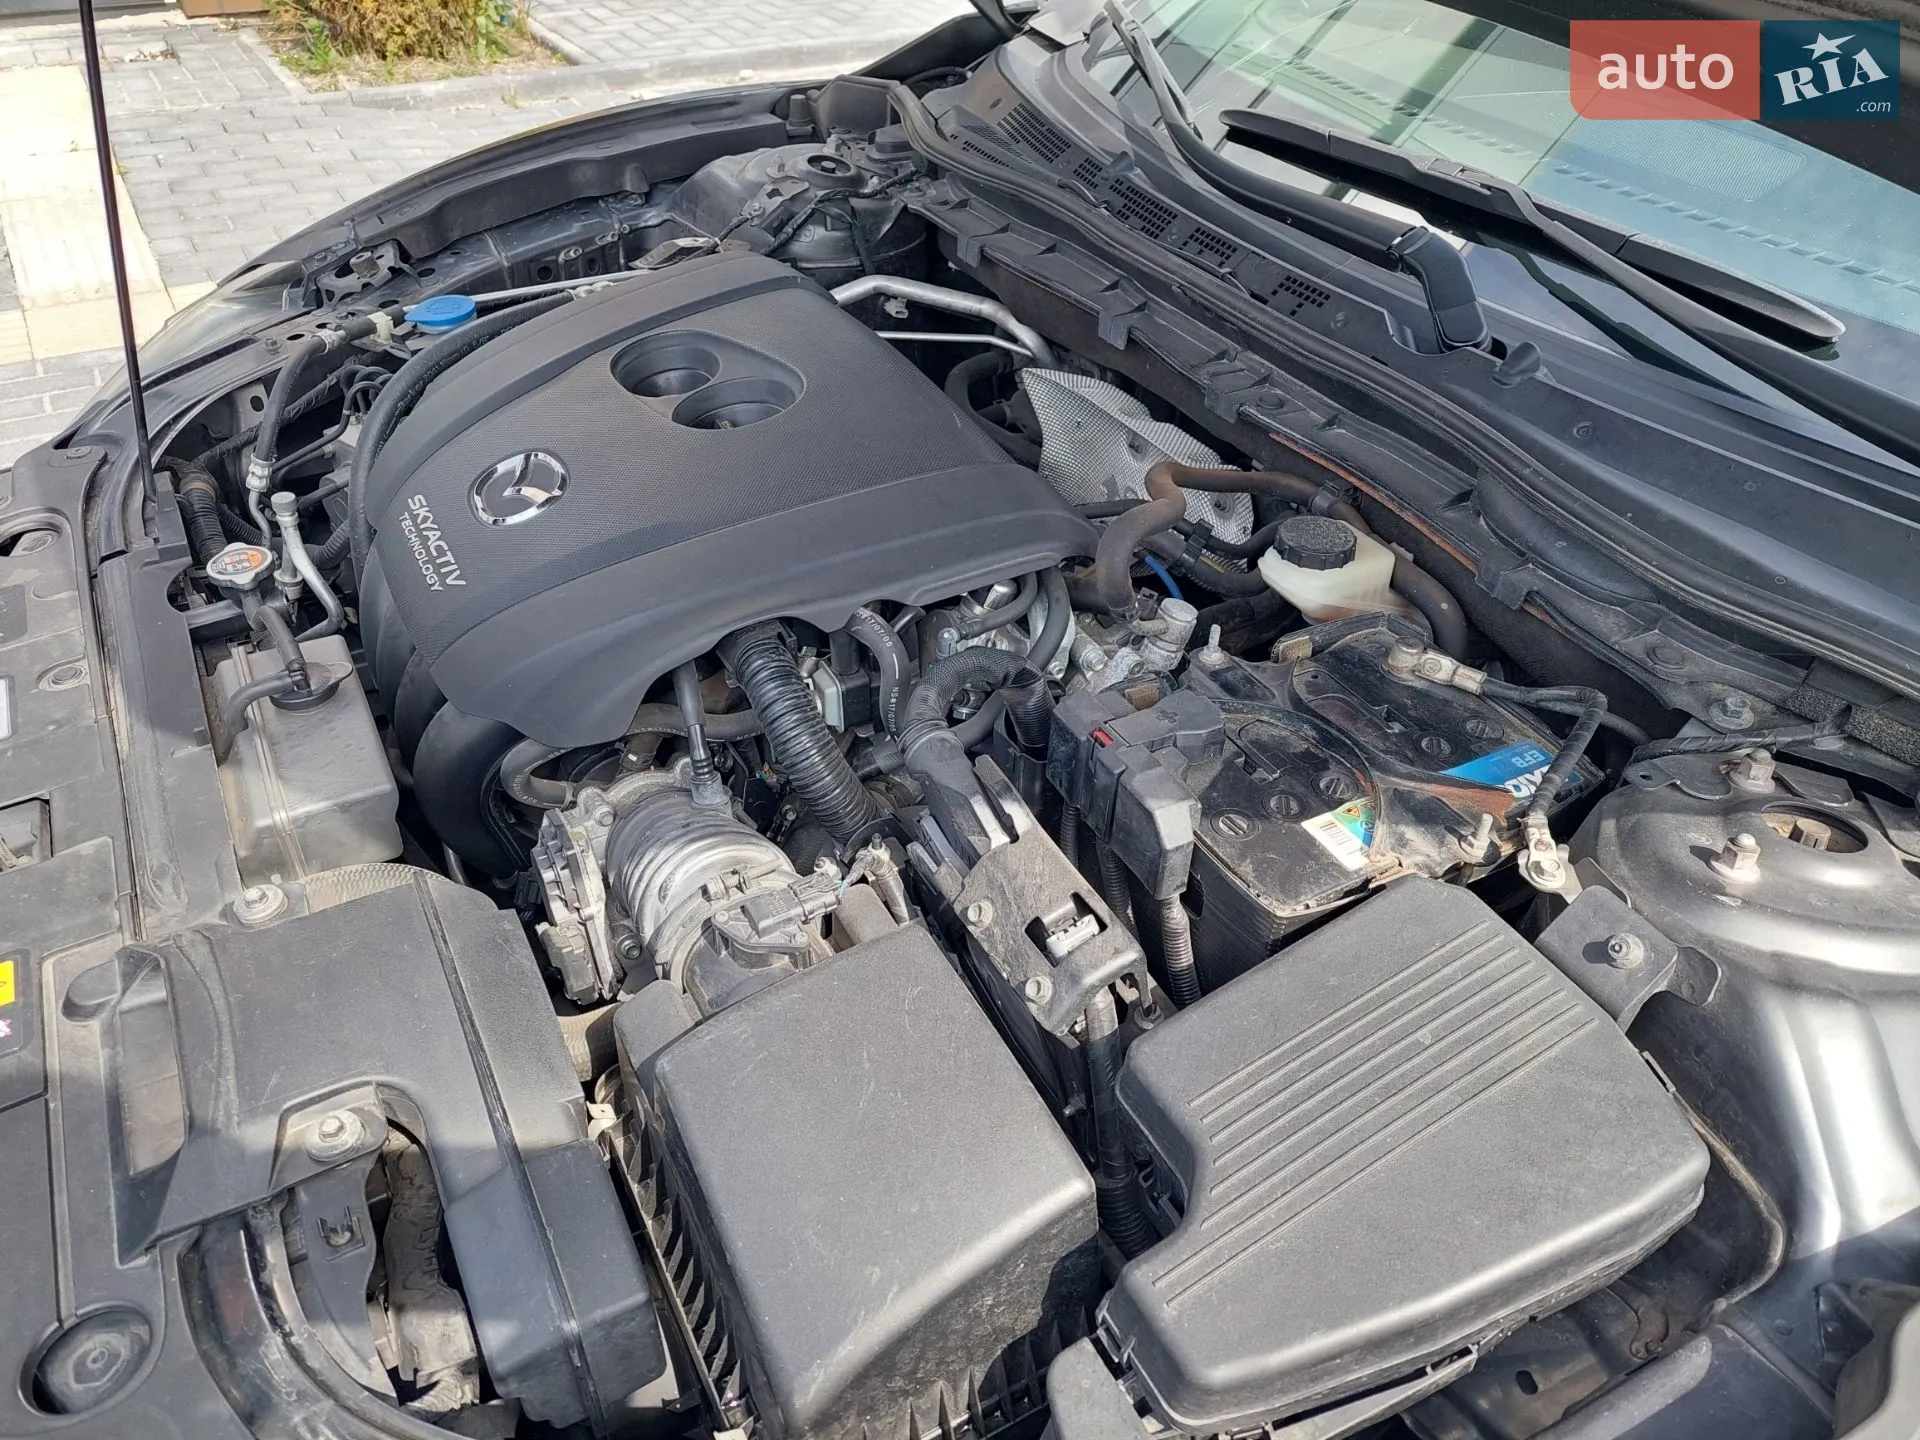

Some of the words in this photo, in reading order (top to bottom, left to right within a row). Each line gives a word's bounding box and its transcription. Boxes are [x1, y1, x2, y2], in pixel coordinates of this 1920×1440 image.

[398, 511, 444, 592] TECHNOLOGY
[407, 494, 467, 586] SKYACTIV
[1511, 749, 1546, 768] EFB
